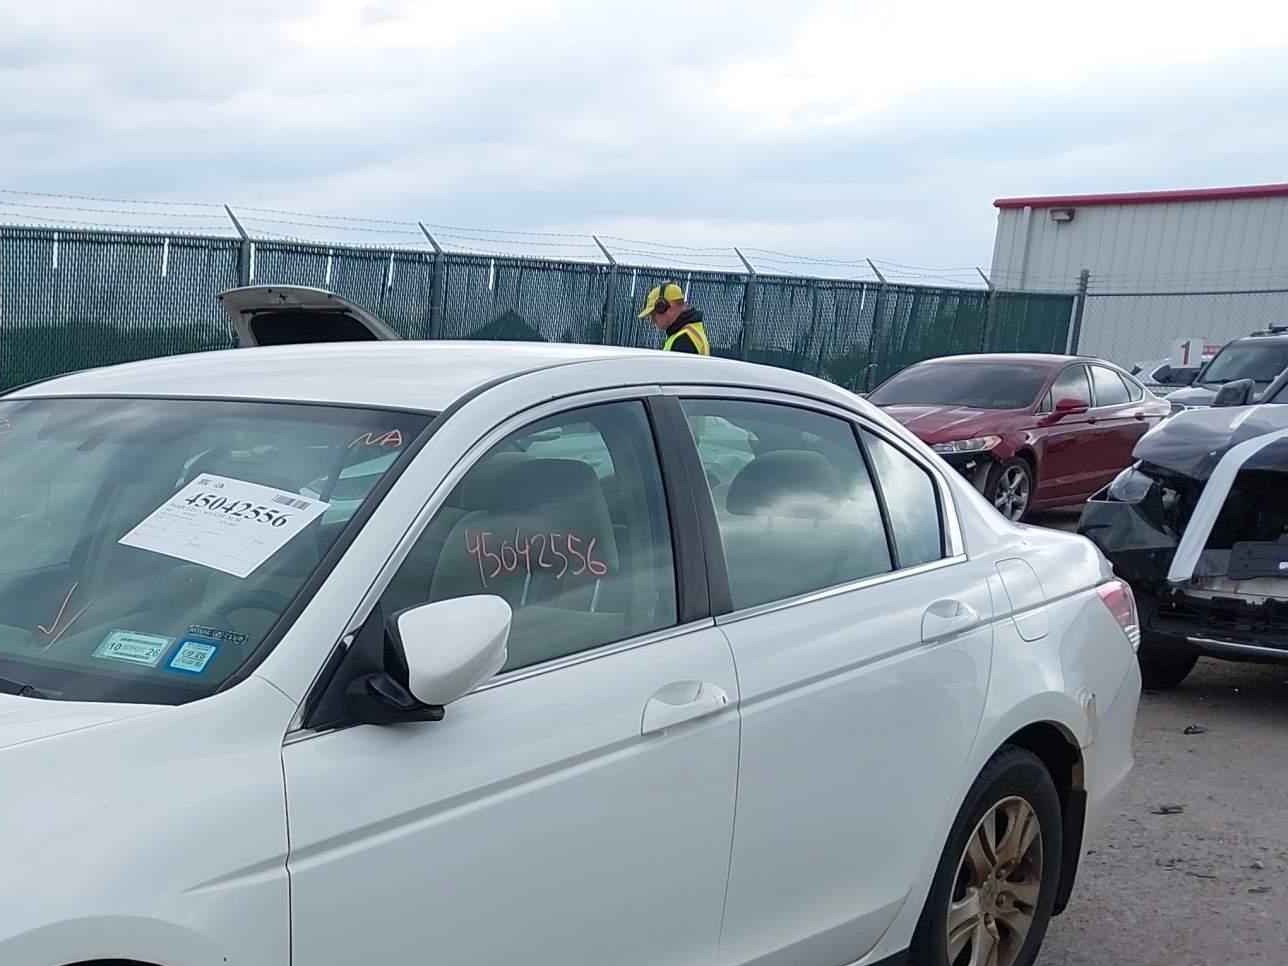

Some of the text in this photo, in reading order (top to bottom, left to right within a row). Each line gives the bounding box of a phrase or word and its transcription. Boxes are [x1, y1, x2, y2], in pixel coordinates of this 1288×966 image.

[1181, 340, 1191, 365] 1
[185, 491, 294, 528] 45042556
[464, 526, 607, 588] 45042556
[108, 642, 122, 651] 10
